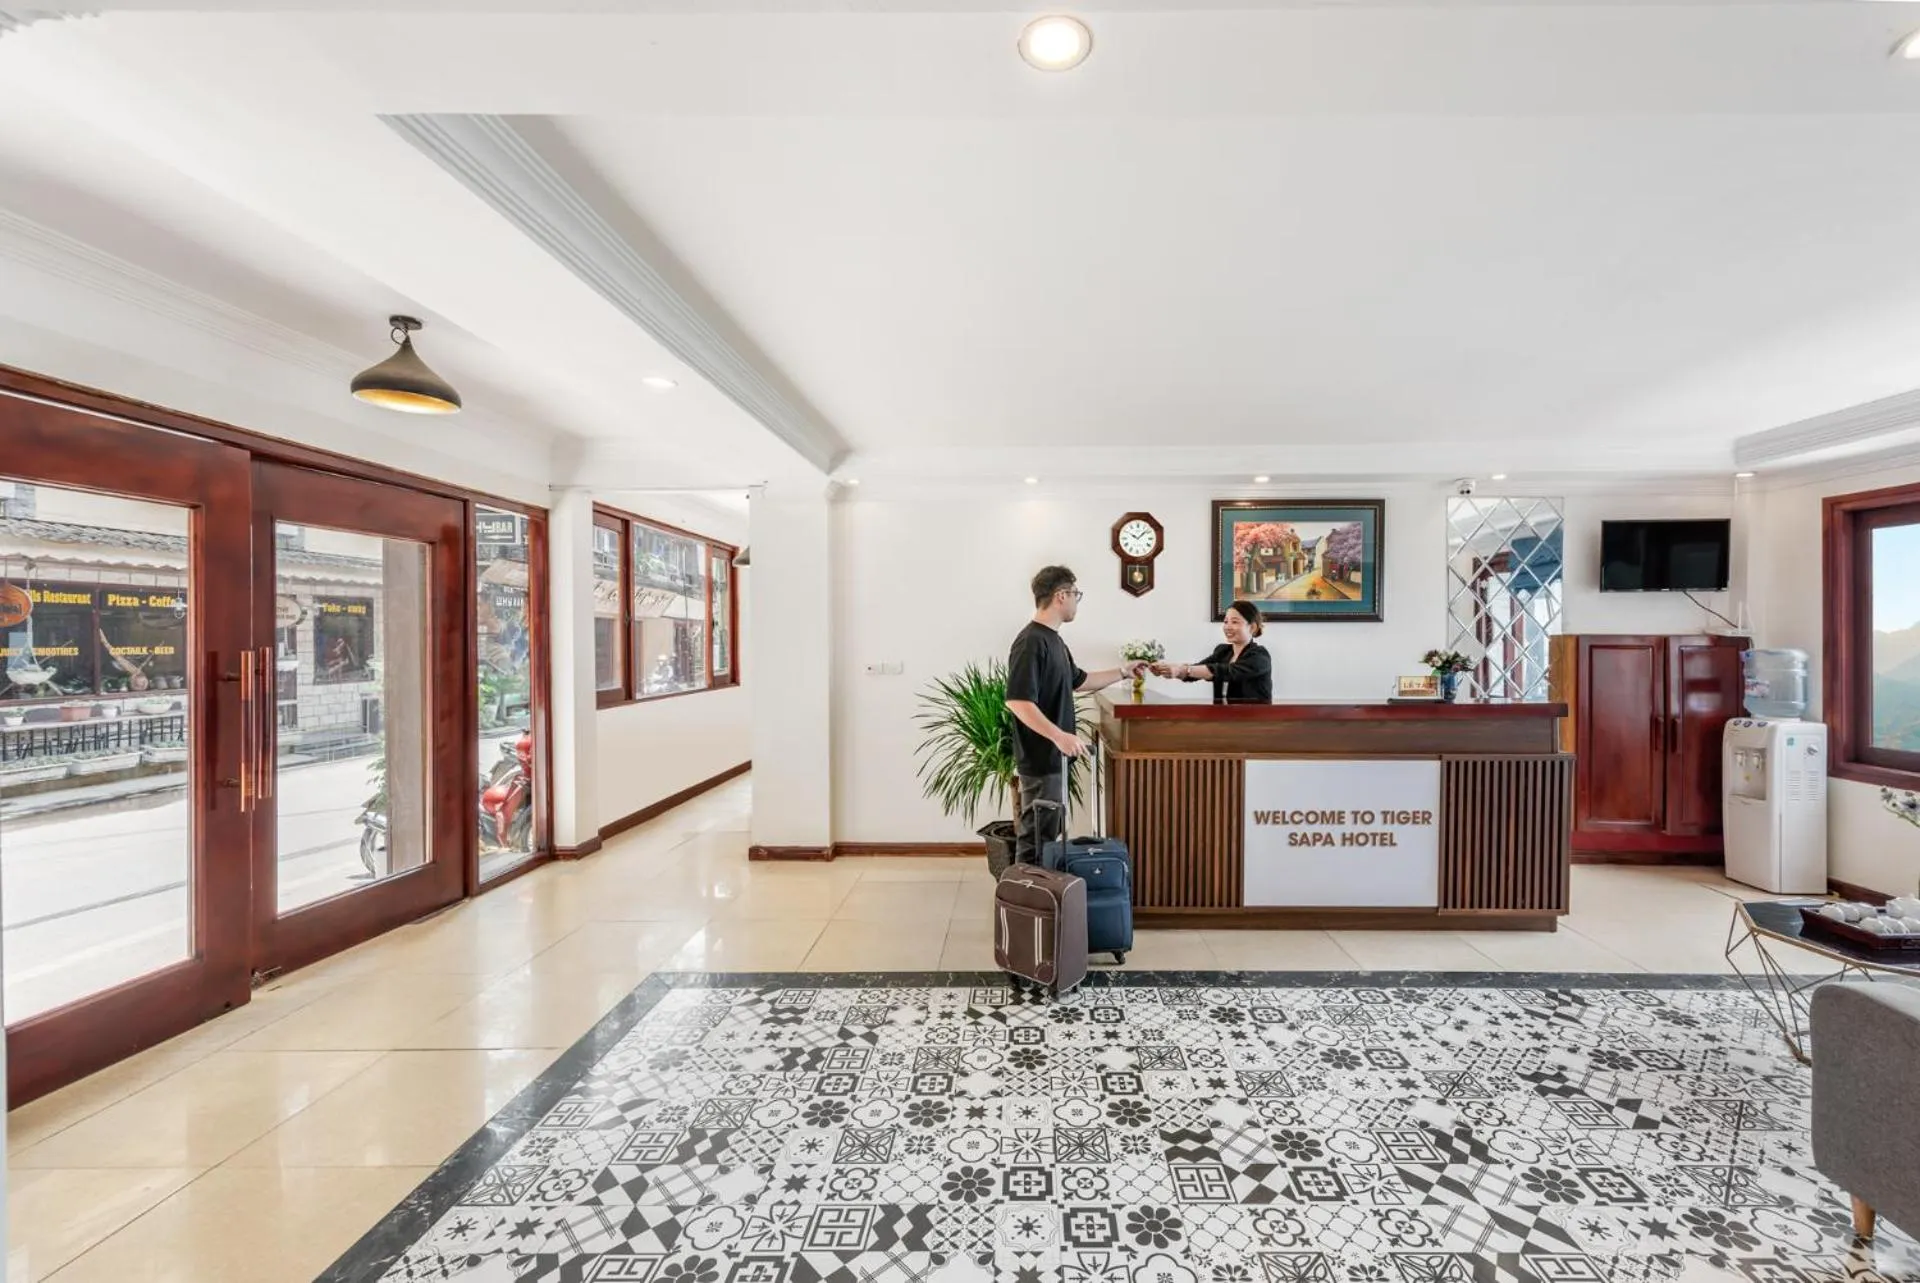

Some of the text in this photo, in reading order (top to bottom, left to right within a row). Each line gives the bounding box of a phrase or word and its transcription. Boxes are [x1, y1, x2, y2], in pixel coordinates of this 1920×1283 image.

[43, 590, 91, 604] Restaurant
[107, 593, 139, 607] Pizza
[1254, 810, 1433, 825] WELCOME TO TIGER
[1288, 832, 1397, 847] SAPA HOTEL
